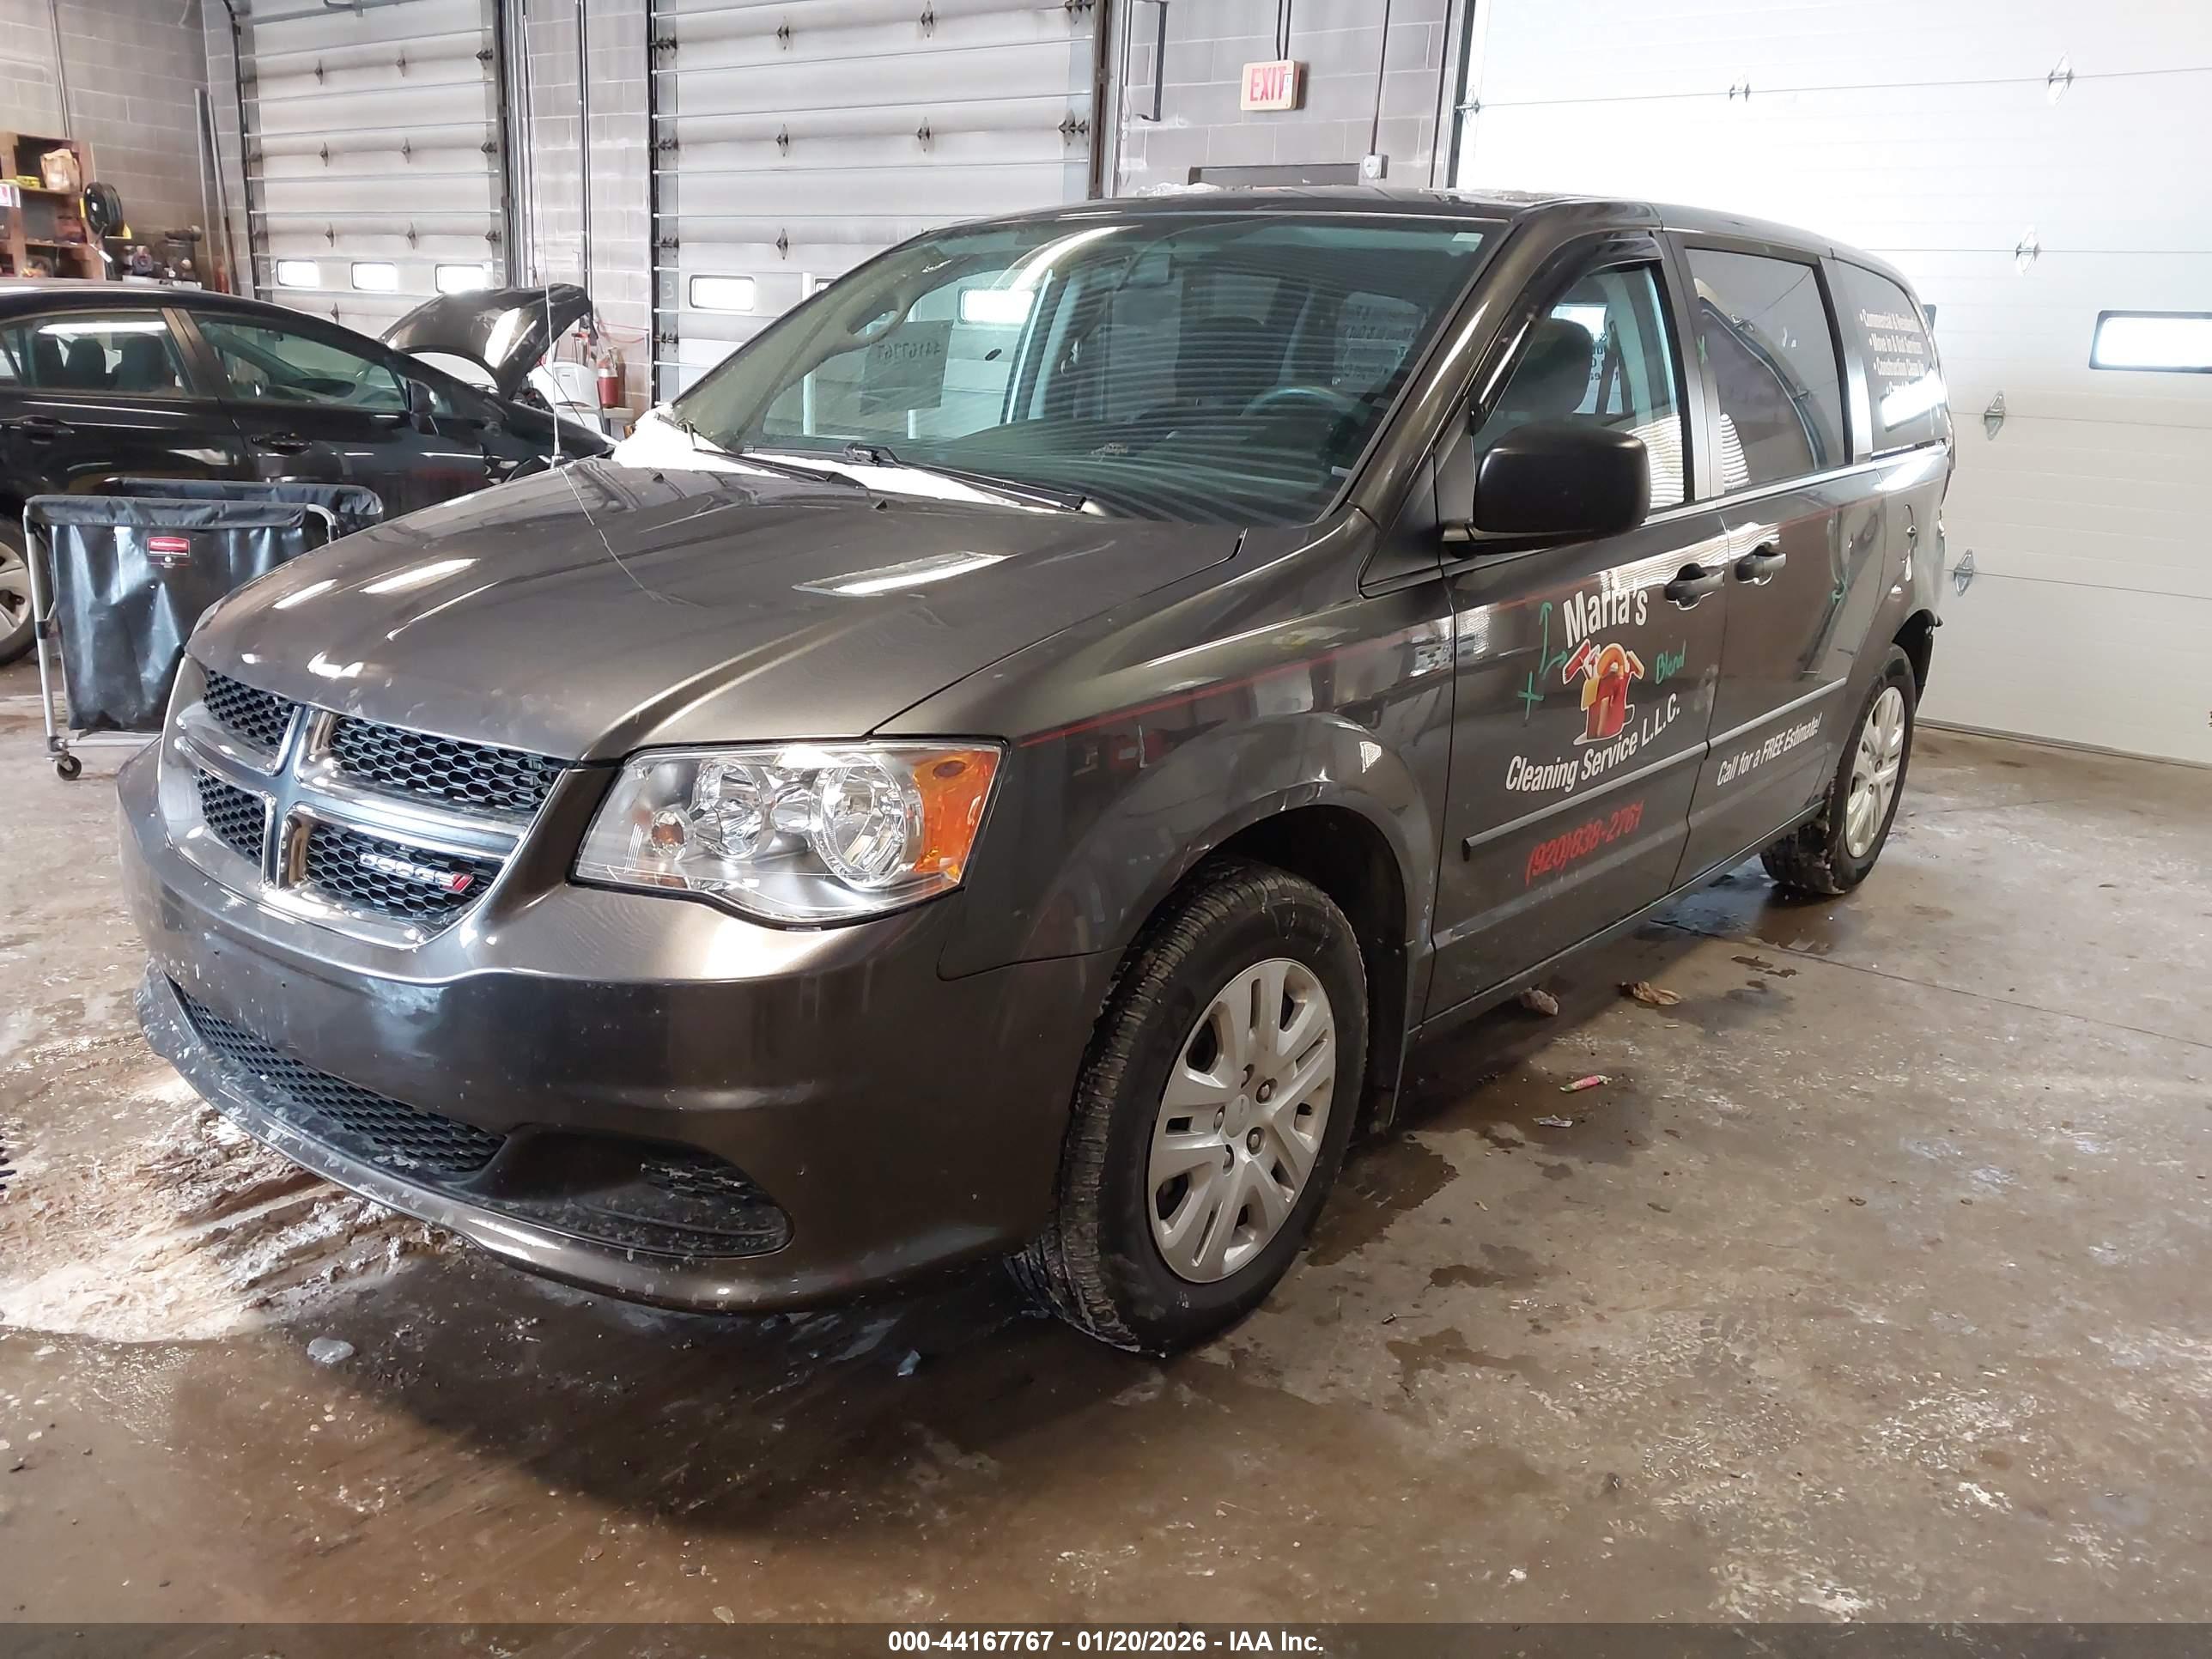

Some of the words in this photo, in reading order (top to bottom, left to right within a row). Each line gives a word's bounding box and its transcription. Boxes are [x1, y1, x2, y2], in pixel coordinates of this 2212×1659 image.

[1250, 66, 1286, 101] EXIT
[1563, 575, 1648, 648] Maria's
[1505, 755, 1579, 793] Cleaning
[1581, 731, 1638, 781] Service
[1641, 693, 1680, 747] L.L.C.
[1717, 755, 1739, 787] Call
[1738, 750, 1753, 776] for
[1753, 749, 1761, 769] a
[1760, 731, 1786, 764] FREE
[1783, 711, 1822, 752] Estimate!
